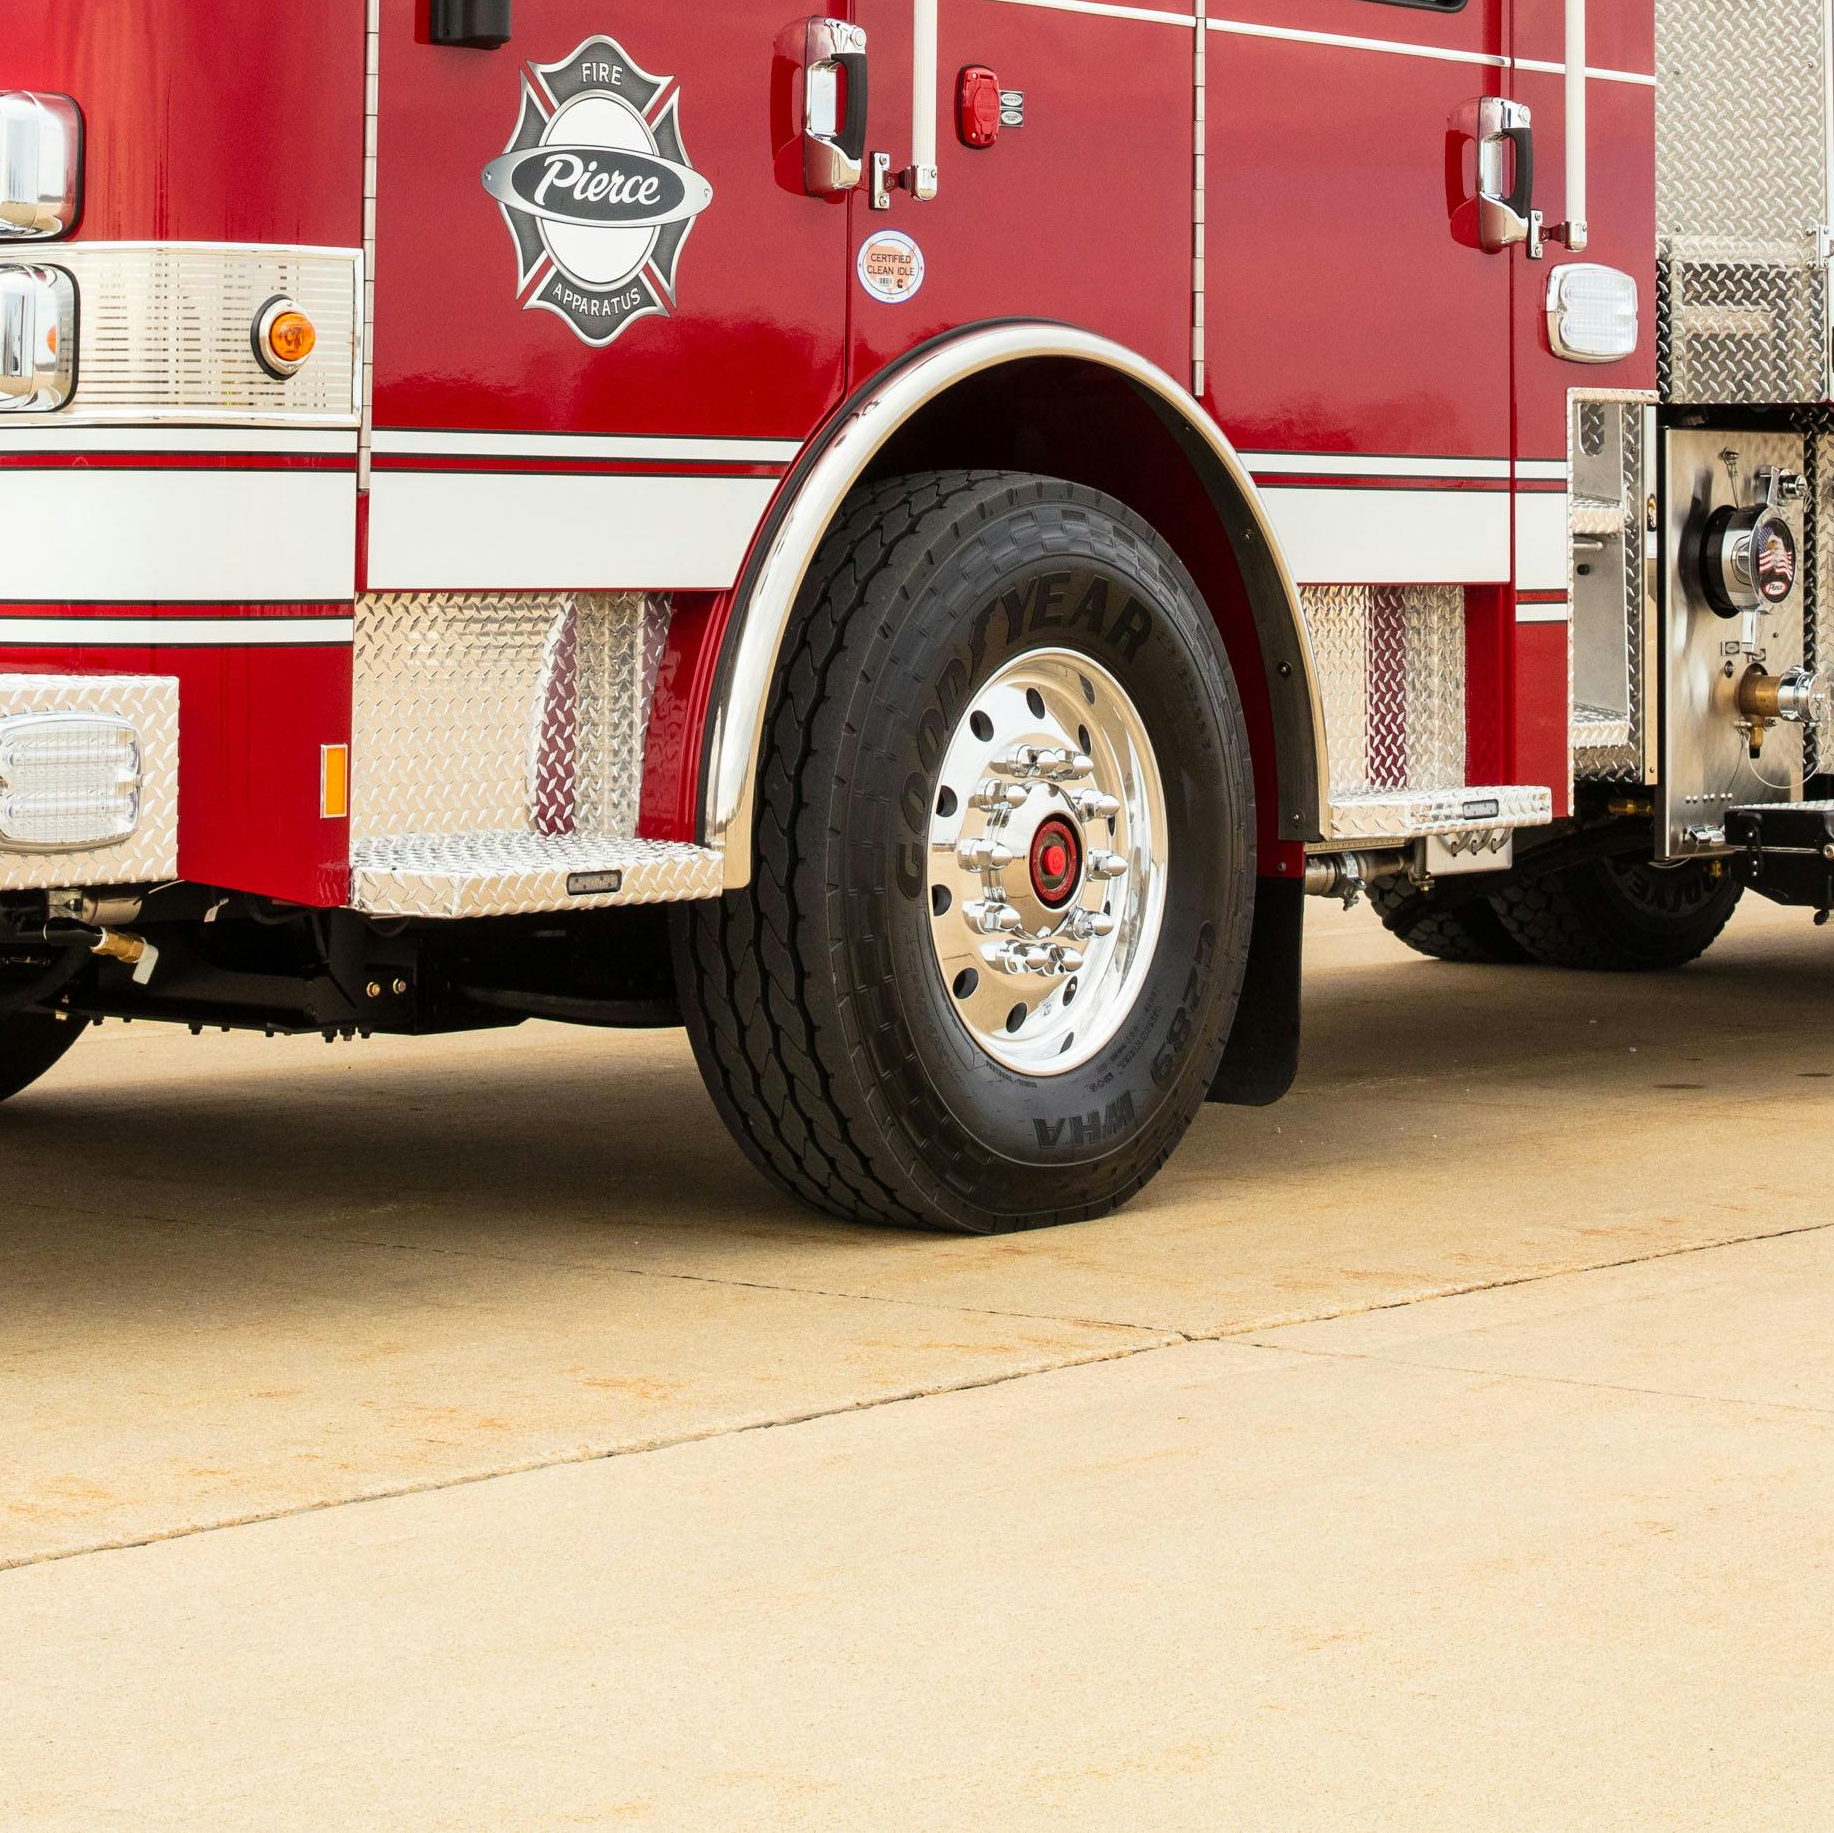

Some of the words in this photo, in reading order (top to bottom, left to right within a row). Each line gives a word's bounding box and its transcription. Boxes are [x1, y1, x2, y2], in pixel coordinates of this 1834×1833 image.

[581, 62, 623, 86] FIRE
[533, 152, 661, 206] Pierce
[866, 264, 894, 275] CLEAN
[897, 267, 916, 276] IDLE
[870, 253, 912, 264] CERTIFIED
[551, 282, 642, 317] APPARATUS
[896, 570, 1154, 902] GOODYEAR
[1032, 1089, 1136, 1150] WHA
